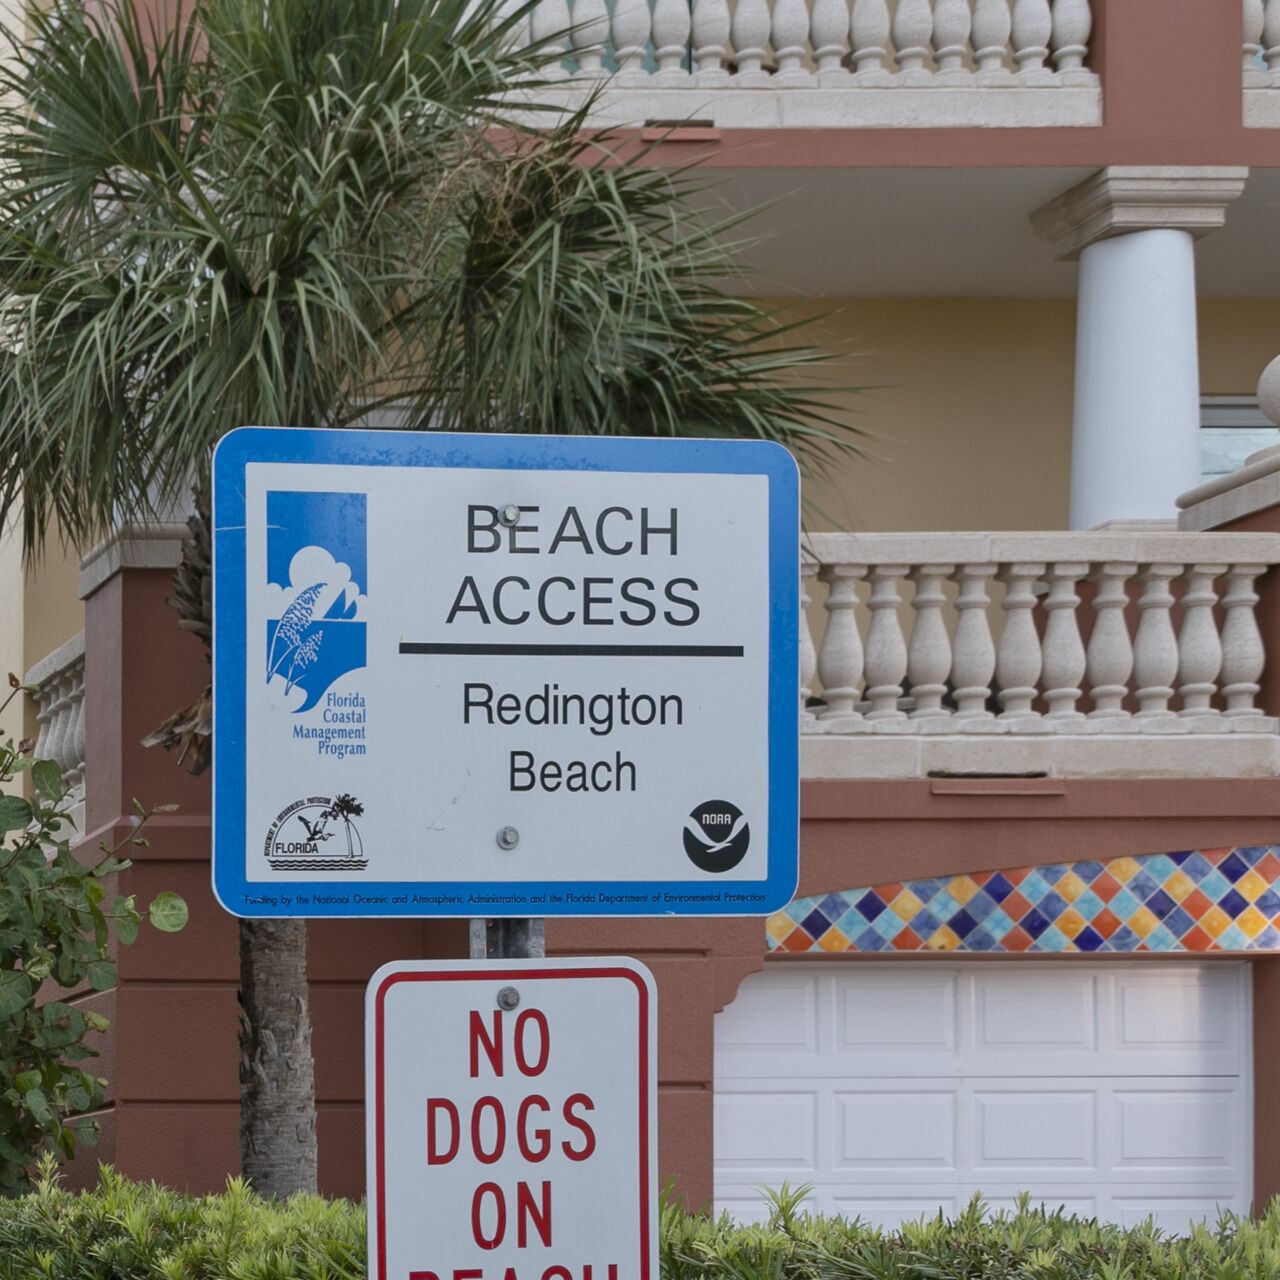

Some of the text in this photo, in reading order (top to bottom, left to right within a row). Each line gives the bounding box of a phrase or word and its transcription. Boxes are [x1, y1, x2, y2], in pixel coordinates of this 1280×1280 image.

[467, 504, 678, 555] BEACH
[446, 576, 700, 626] ACCESS
[327, 692, 365, 708] Florida
[464, 683, 683, 736] Redington
[323, 709, 366, 723] Coastal
[293, 724, 366, 743] Management
[318, 741, 366, 759] Program
[510, 751, 636, 792] Beach
[702, 814, 731, 824] NOAA
[276, 842, 318, 853] FLORIDA
[244, 893, 766, 906] Funding by the National Oceanic and Atmospheric Administration and the Florida Department of Environmental Protection
[469, 1008, 551, 1078] NO
[427, 1093, 596, 1165] DOGS
[471, 1180, 552, 1251] ON
